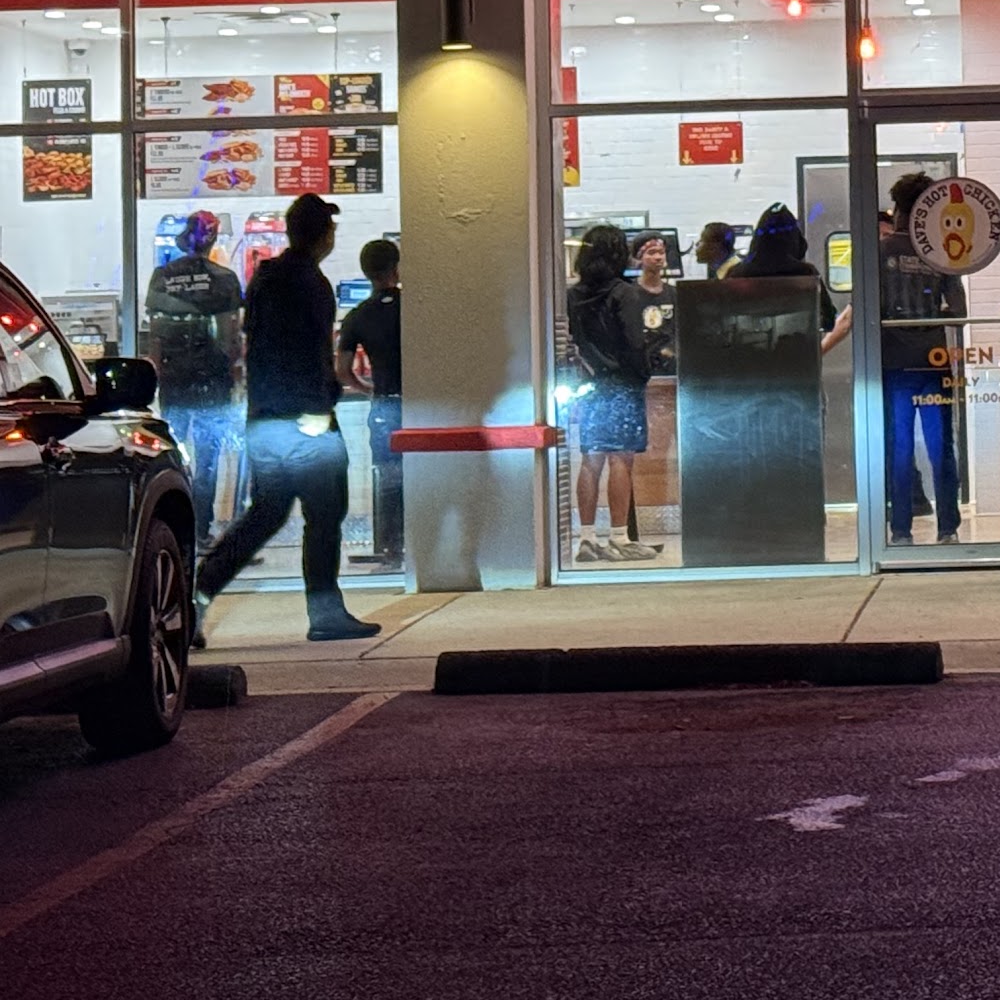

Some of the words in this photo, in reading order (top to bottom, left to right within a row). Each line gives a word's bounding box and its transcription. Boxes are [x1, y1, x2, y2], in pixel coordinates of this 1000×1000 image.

[29, 87, 56, 108] HOT
[58, 86, 86, 107] BOX
[922, 185, 948, 208] HOT
[914, 208, 935, 255] DAVE'S
[928, 346, 994, 367] OPEN
[942, 377, 980, 389] DAILY
